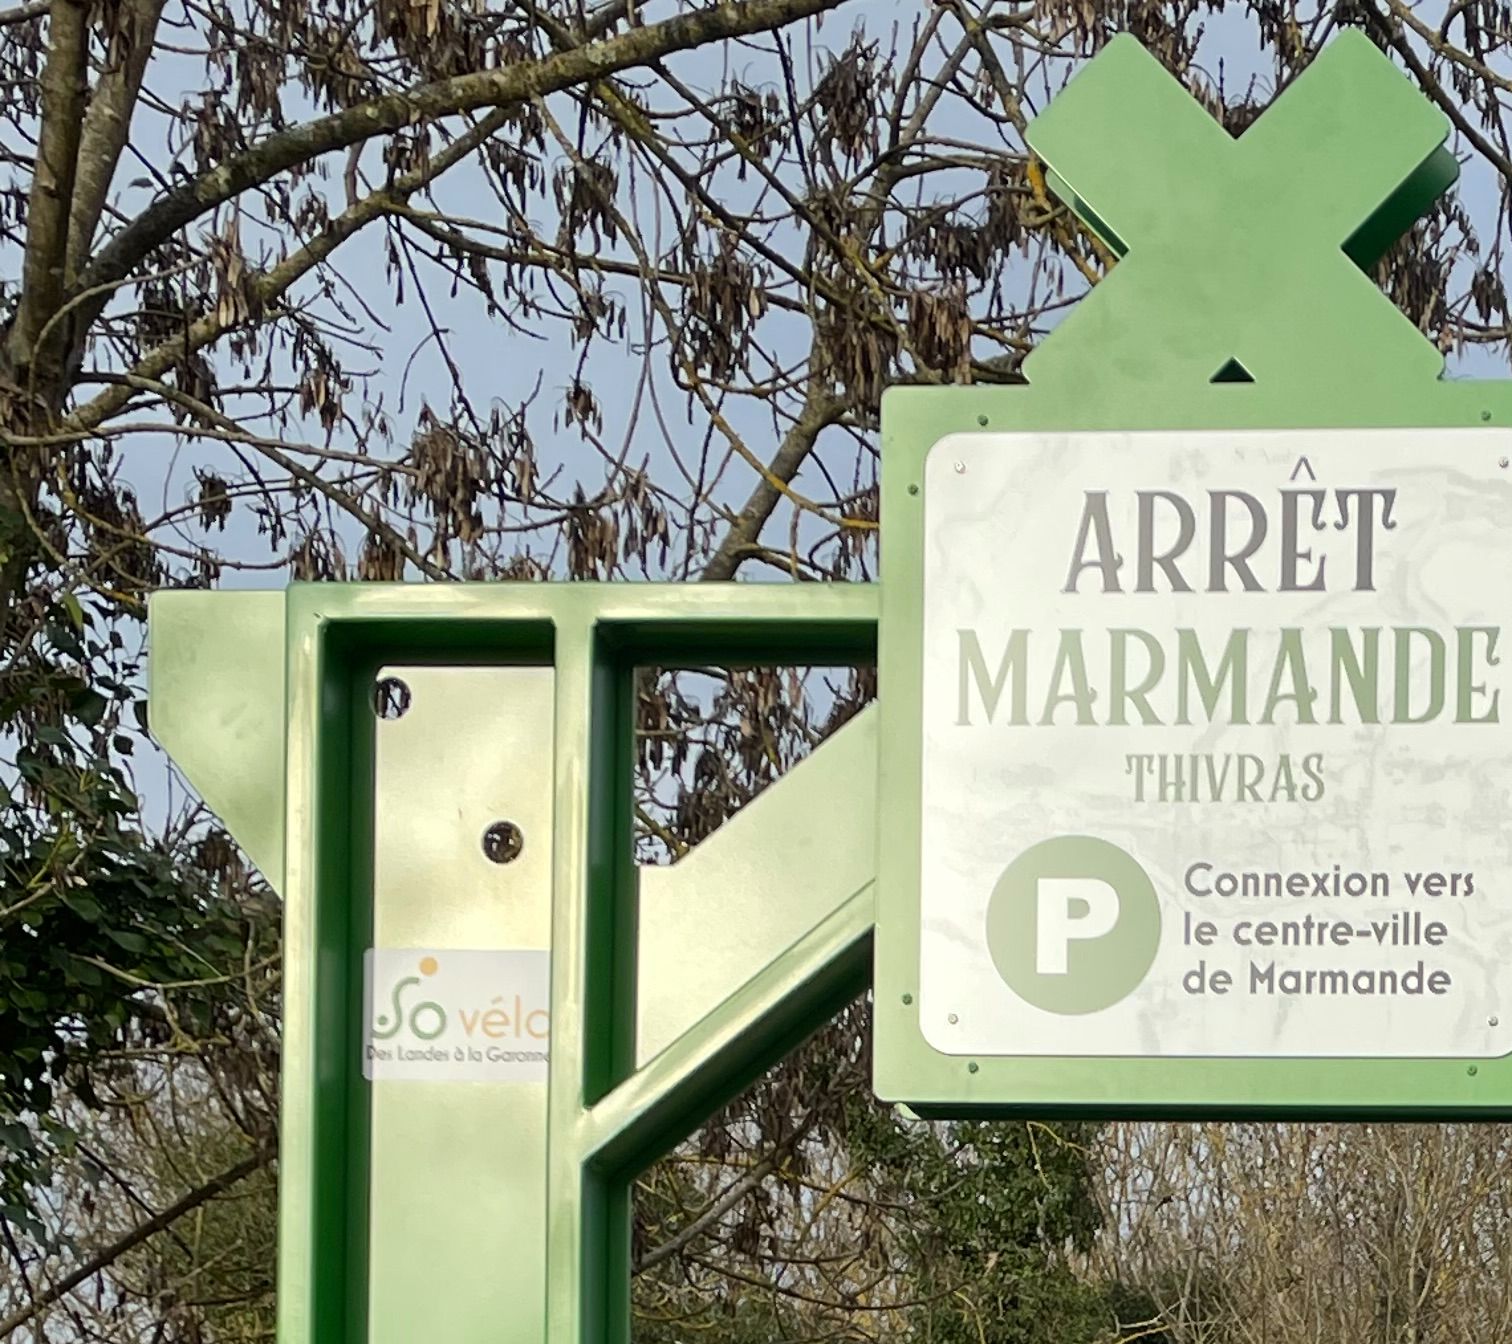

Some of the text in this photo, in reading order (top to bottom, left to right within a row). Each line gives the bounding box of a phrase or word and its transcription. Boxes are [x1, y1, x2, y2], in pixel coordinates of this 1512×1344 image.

[1060, 456, 1398, 594] ARRÊT
[953, 625, 1501, 727] MARMANDE
[1124, 752, 1326, 803] THIVRAS
[1183, 862, 1475, 898] Connexion vers
[1035, 876, 1120, 975] P
[1183, 911, 1449, 947] le centre-ville
[1182, 961, 1452, 996] de Marmande
[399, 1045, 449, 1062] Landes
[454, 1045, 465, 1062] à
[468, 1045, 482, 1062] la
